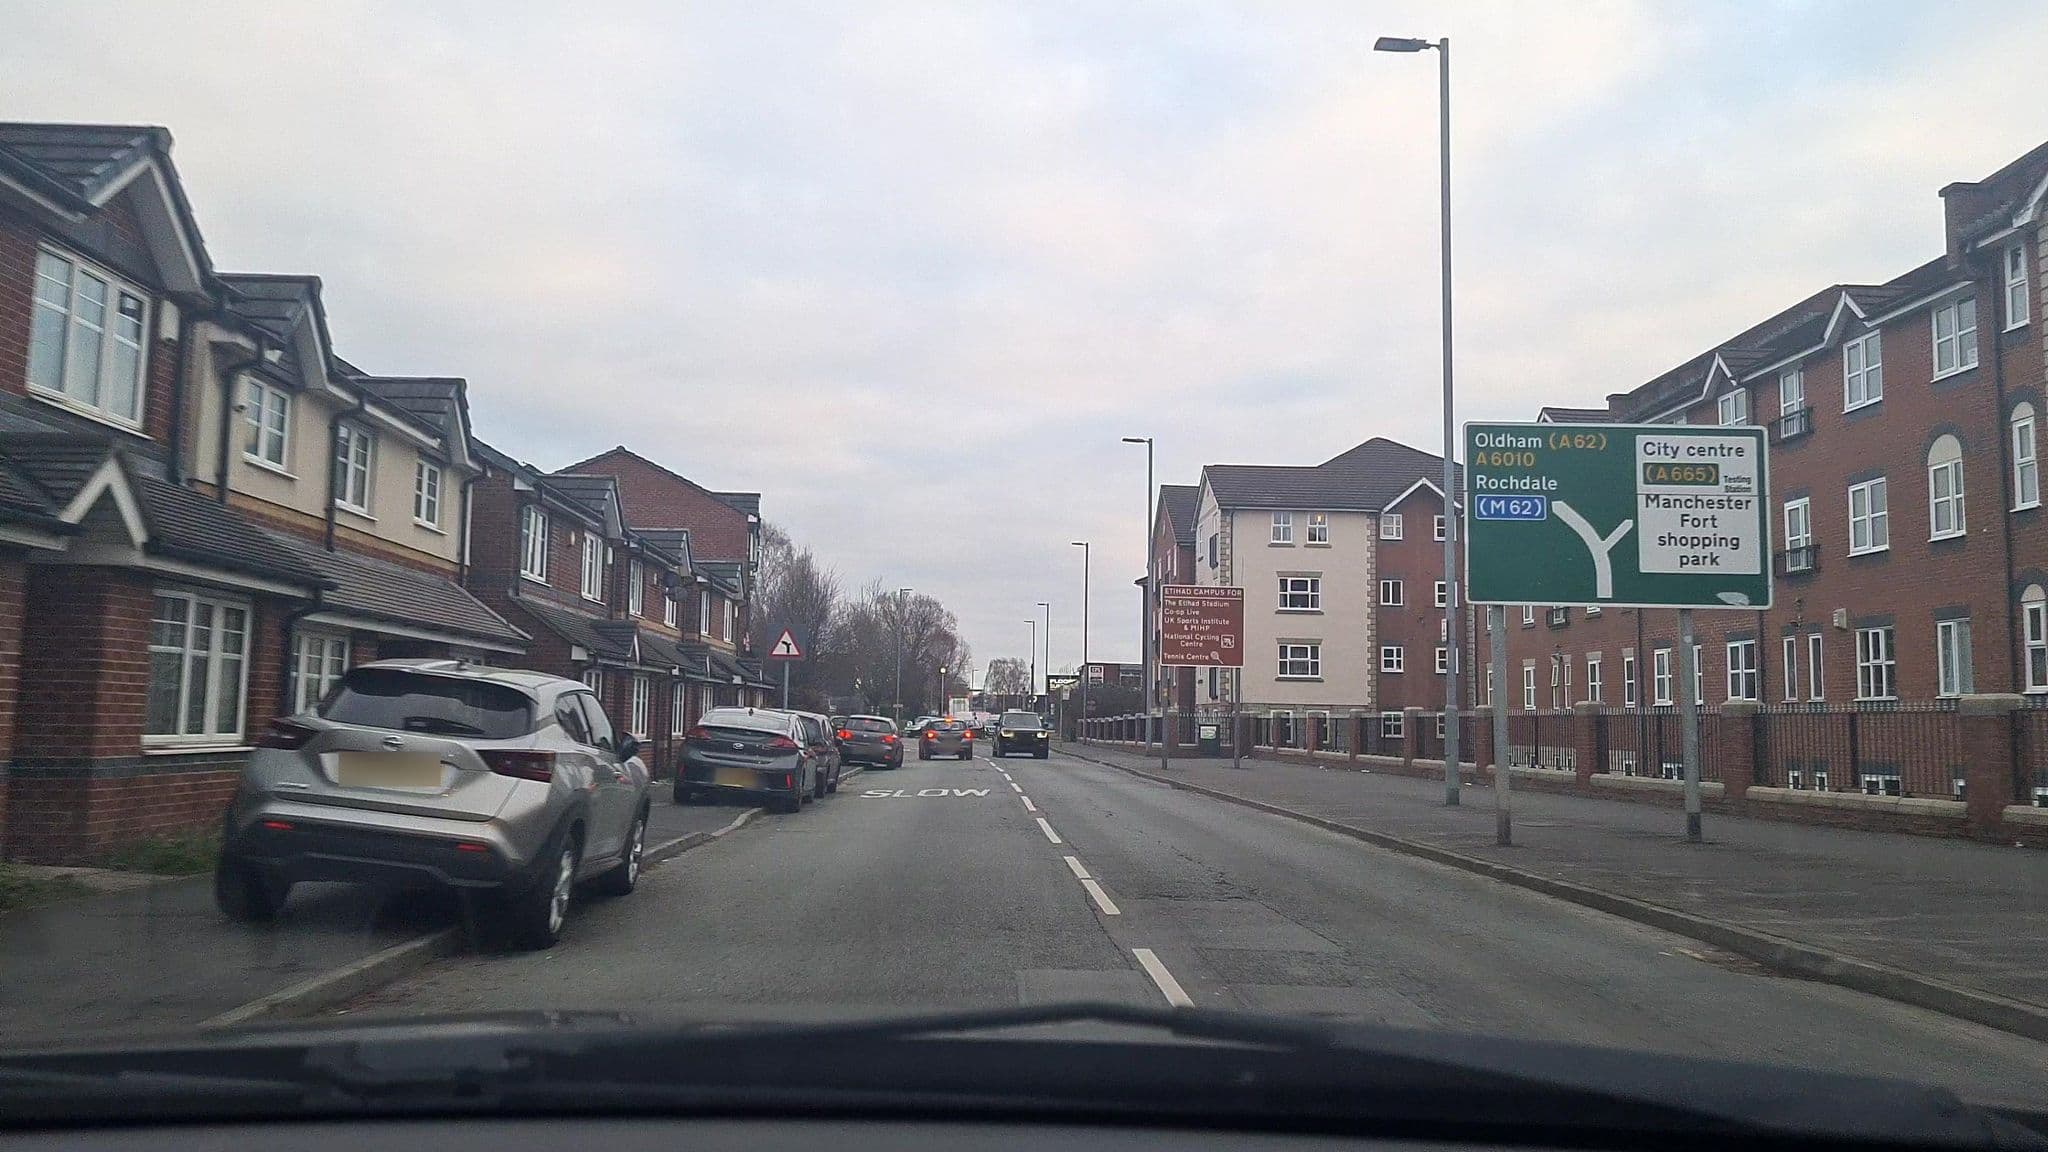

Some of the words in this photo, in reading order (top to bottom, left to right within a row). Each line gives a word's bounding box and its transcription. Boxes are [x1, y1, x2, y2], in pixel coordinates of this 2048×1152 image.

[1475, 432, 1542, 448] Oldham
[1643, 442, 1679, 458] City
[1687, 443, 1744, 457] centre
[1476, 451, 1535, 466] A6010
[1646, 464, 1716, 482] (A665)
[1724, 476, 1751, 484] Testing
[1476, 475, 1558, 490] Rochdale
[1480, 498, 1542, 516] (M62)
[1645, 494, 1751, 510] Manchester
[1680, 514, 1718, 528] Fort
[1658, 532, 1740, 550] shopping
[1680, 552, 1720, 568] park
[860, 789, 990, 798] SLOW
